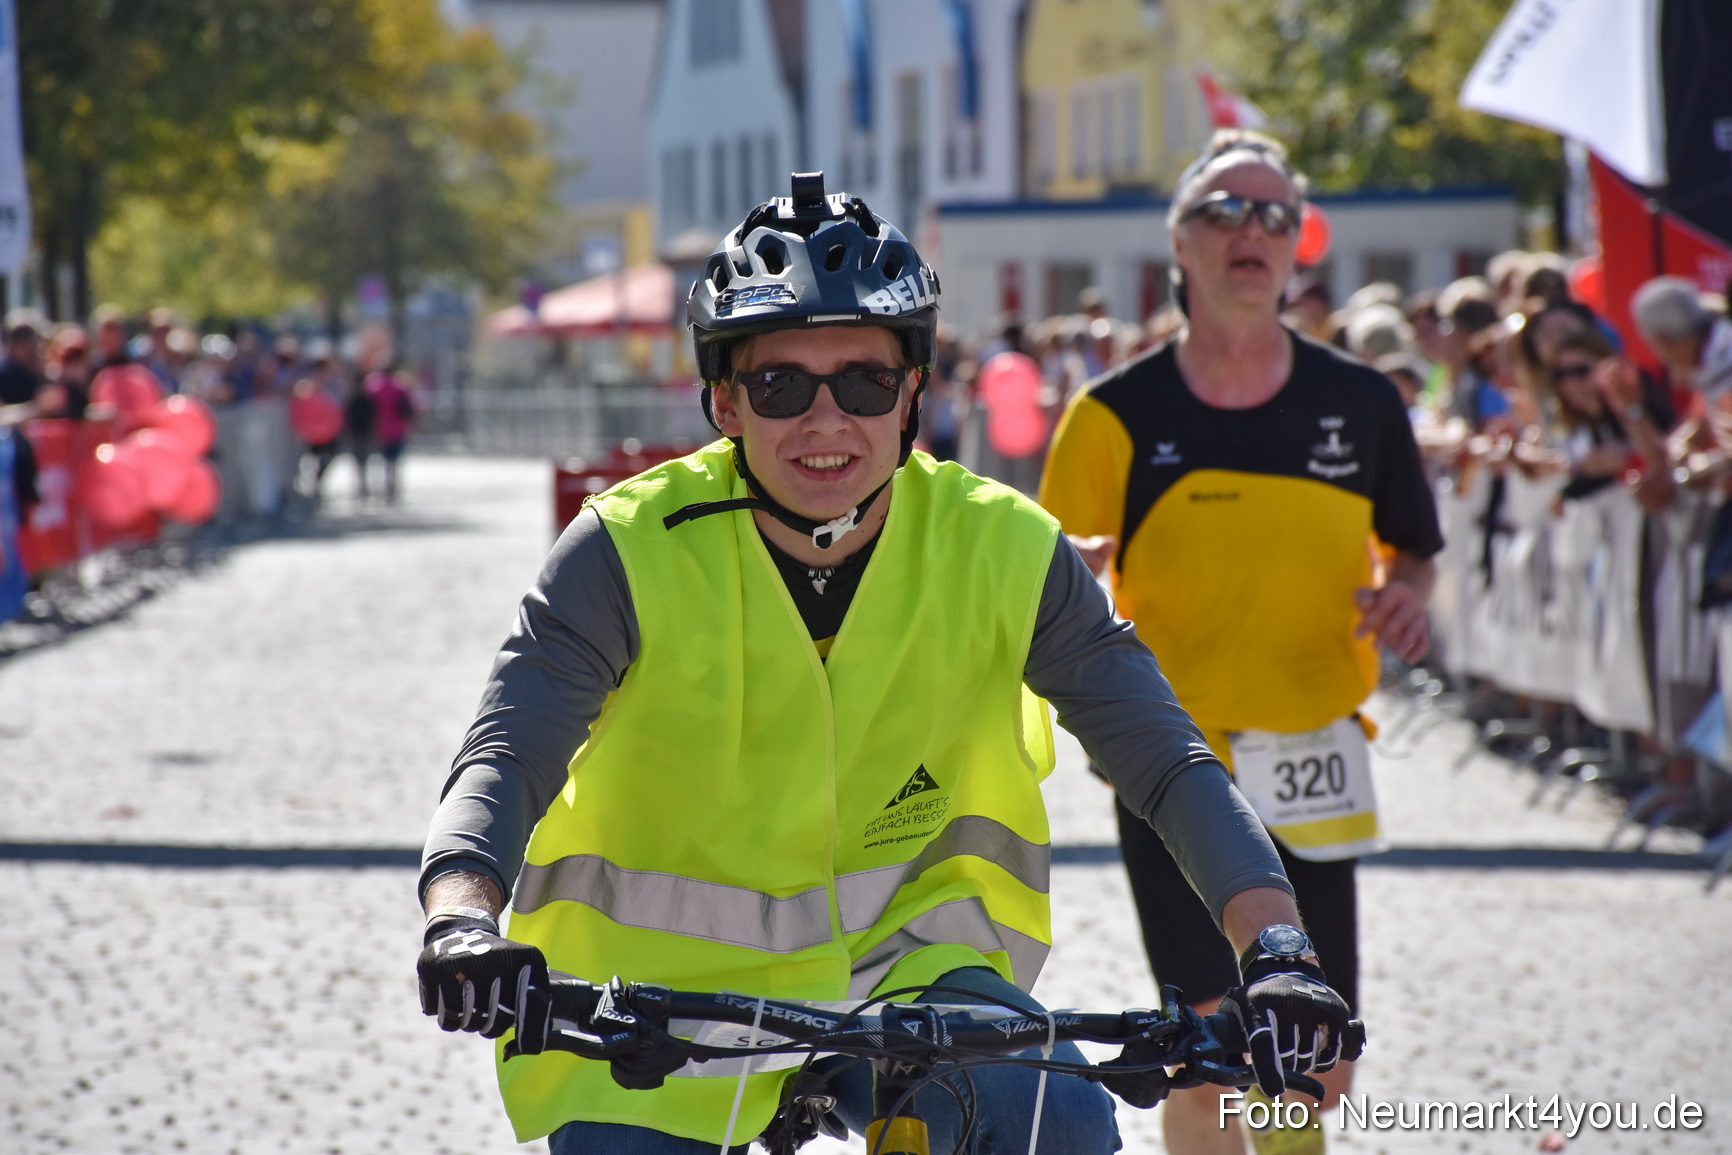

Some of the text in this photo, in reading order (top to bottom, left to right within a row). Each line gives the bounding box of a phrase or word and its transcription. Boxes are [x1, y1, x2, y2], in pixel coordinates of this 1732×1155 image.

[862, 271, 936, 316] BELL
[1275, 753, 1346, 803] 320
[864, 817, 911, 838] EINFACH
[727, 995, 839, 1031] RACEFACE
[1012, 1015, 1084, 1034] TURINE
